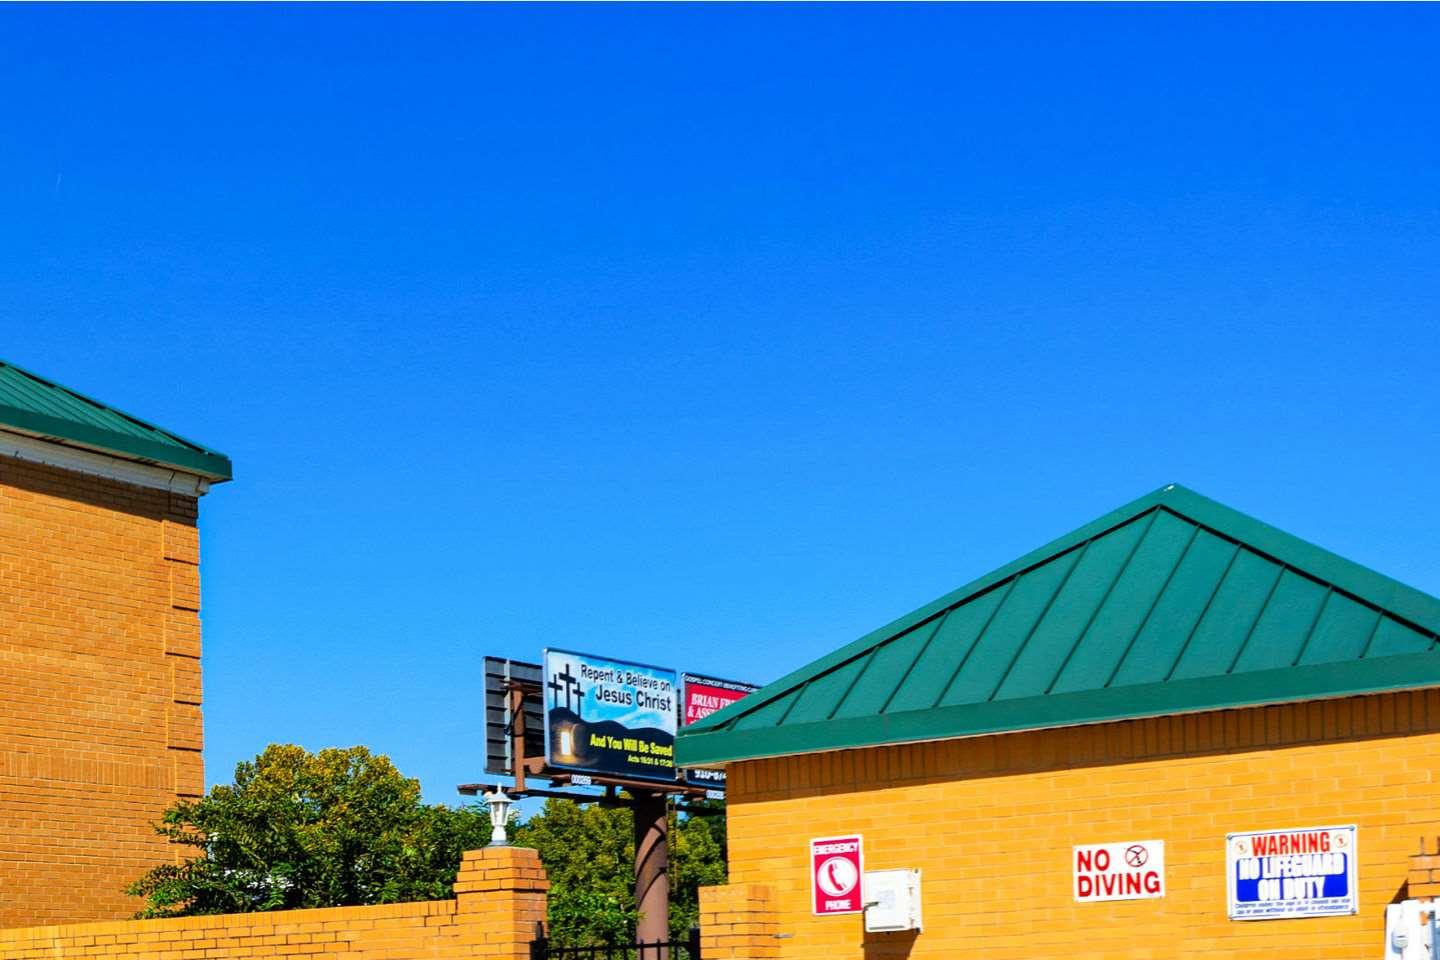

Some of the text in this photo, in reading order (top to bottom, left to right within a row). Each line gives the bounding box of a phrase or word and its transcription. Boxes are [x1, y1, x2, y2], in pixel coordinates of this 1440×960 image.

[581, 664, 671, 691] Repent & Believe on
[595, 684, 671, 712] Jesus Christ
[691, 693, 719, 709] BRIAN
[687, 705, 695, 718] &
[590, 733, 673, 757] And You Will Be Saved
[1251, 832, 1330, 857] WARNING
[1077, 849, 1110, 872] NO
[1238, 853, 1345, 880] NO LIFEGUARD
[1077, 872, 1161, 897] DIVING
[1258, 877, 1325, 901] ON DUTY
[825, 899, 852, 911] PHONE
